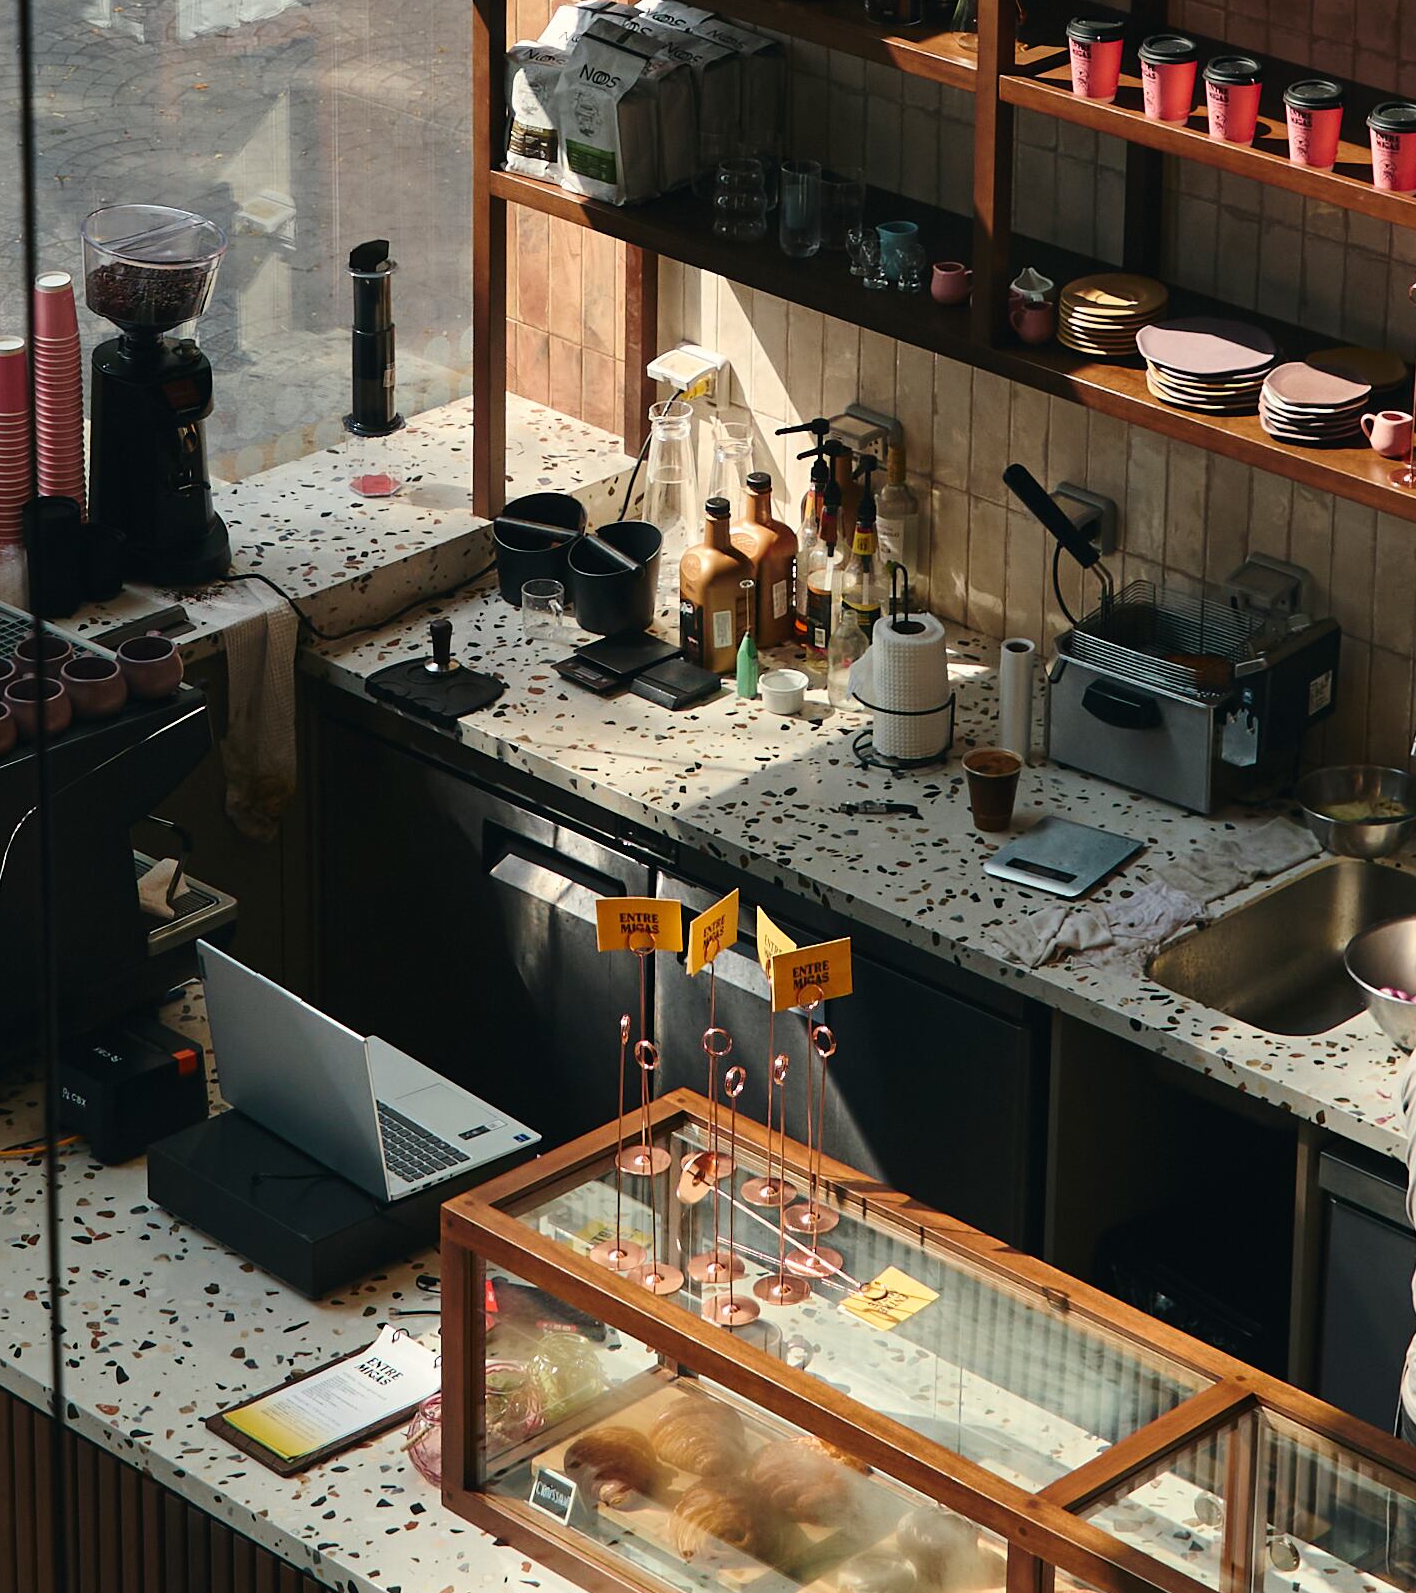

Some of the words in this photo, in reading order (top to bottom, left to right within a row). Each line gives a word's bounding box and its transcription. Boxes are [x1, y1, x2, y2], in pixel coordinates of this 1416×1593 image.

[579, 64, 621, 89] NOOS
[619, 913, 660, 924] ENTRE
[620, 924, 660, 934] MIGAS
[793, 960, 830, 978] ENTRE
[793, 972, 830, 990] MIGAS
[354, 1364, 392, 1386] MIGAS
[366, 1357, 404, 1381] ENTRE
